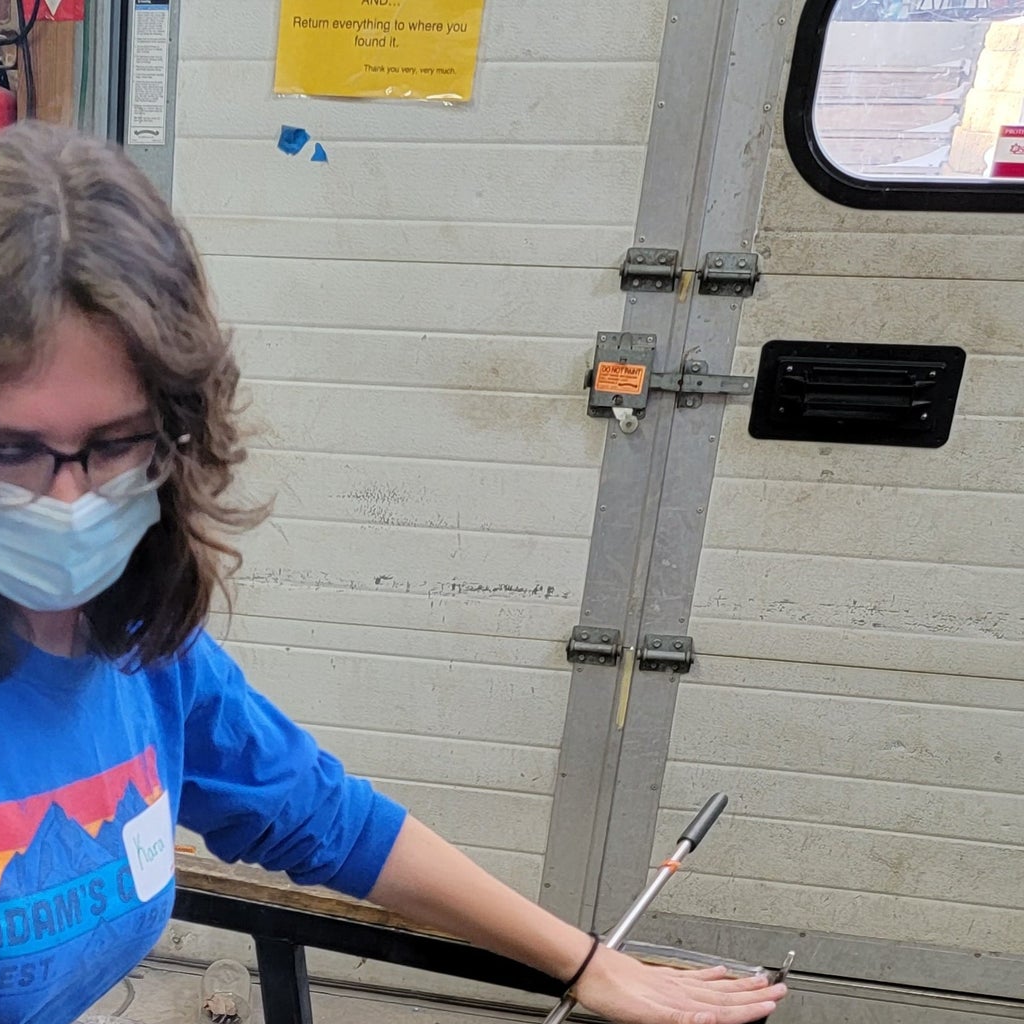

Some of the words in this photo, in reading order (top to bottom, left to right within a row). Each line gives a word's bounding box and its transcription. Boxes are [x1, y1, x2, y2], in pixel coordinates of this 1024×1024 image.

[293, 16, 329, 29] Return
[332, 18, 390, 33] everything
[394, 20, 405, 31] to
[408, 20, 443, 32] where
[446, 22, 467, 35] you
[354, 35, 386, 48] found
[389, 36, 399, 48] it.
[363, 63, 385, 73] Thank
[387, 66, 399, 75] you
[420, 67, 434, 76] very
